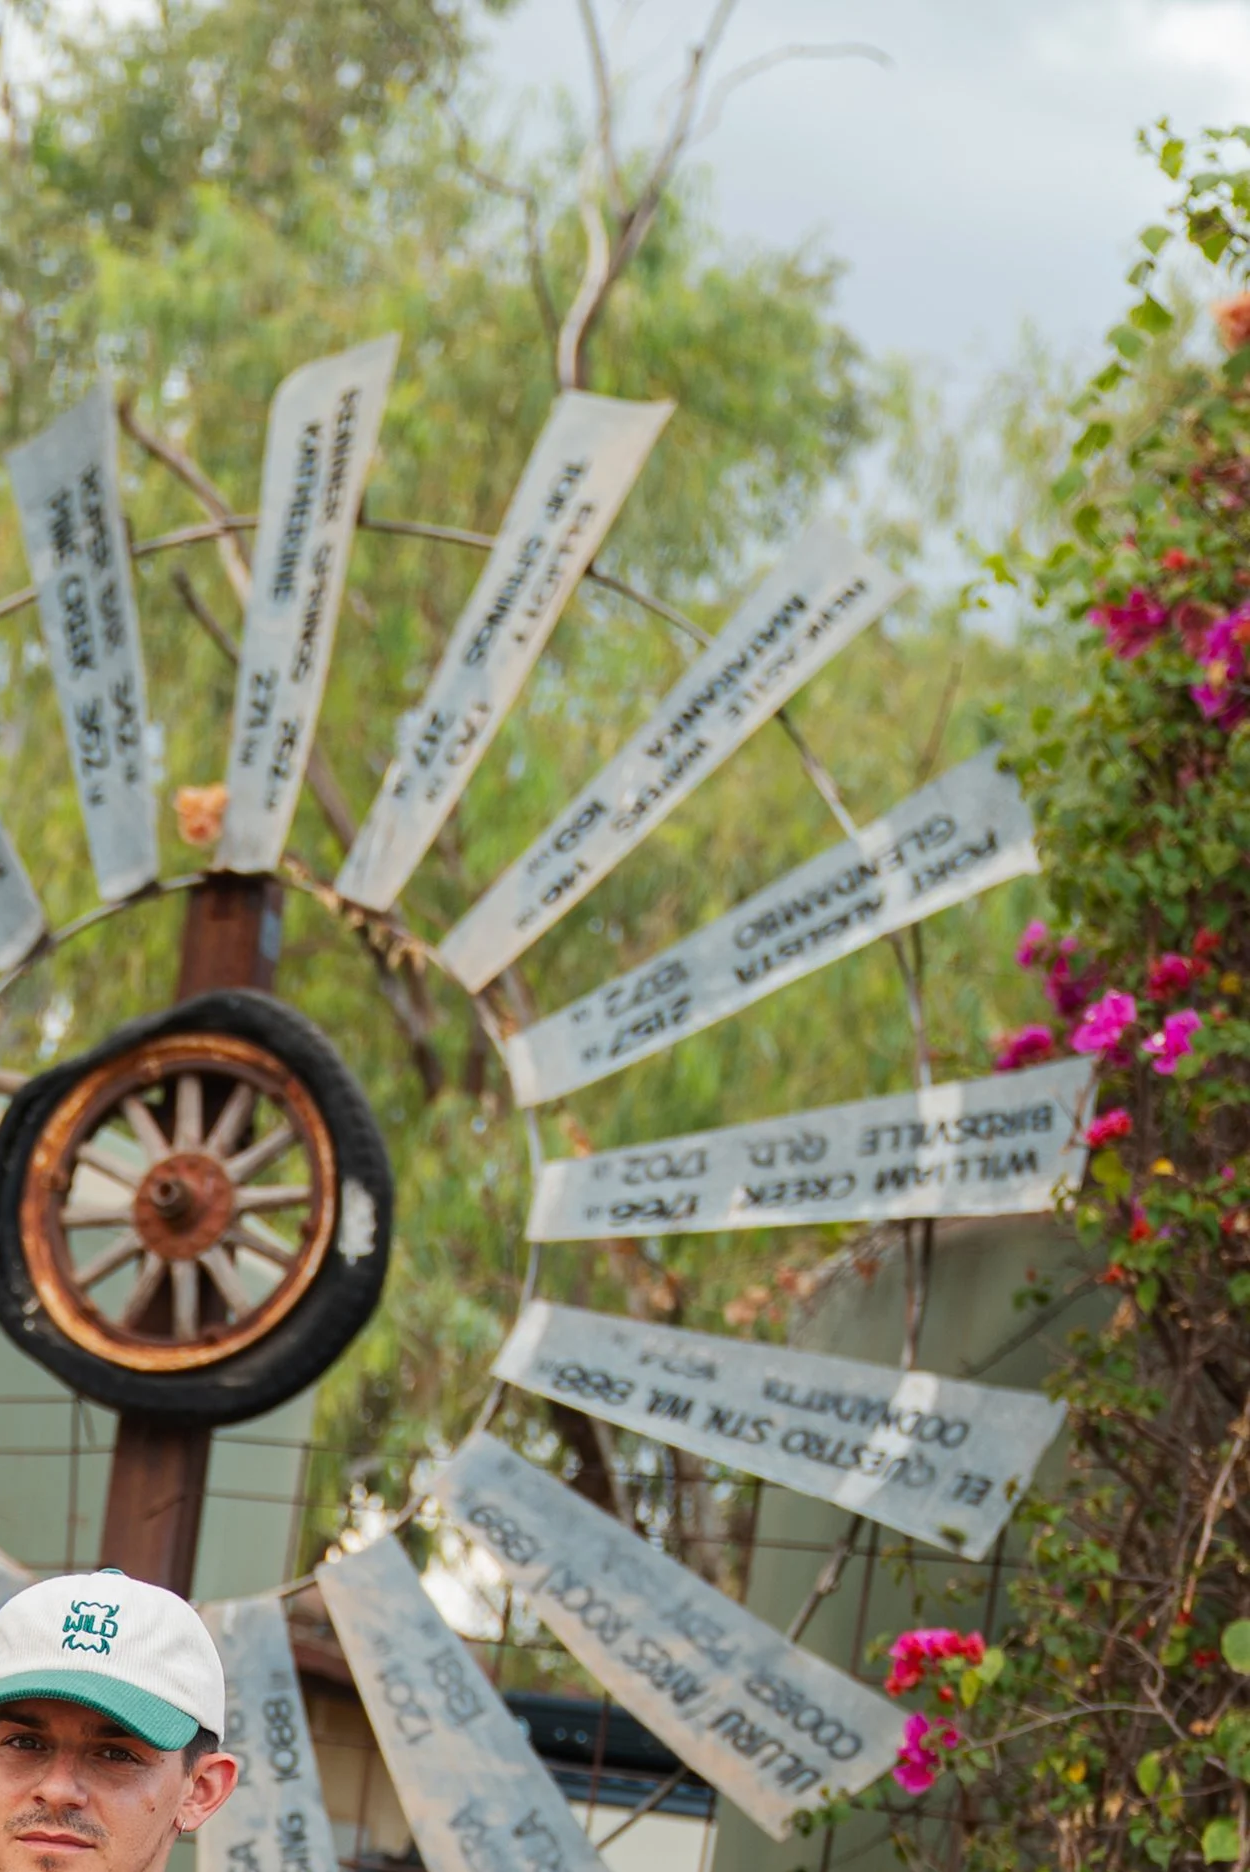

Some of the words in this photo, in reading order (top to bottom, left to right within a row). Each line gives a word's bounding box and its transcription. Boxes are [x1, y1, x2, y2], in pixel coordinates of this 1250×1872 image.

[269, 420, 323, 602] KATHERINE
[540, 457, 588, 524] TOP
[288, 542, 333, 684] SPRINGS
[461, 534, 546, 670] SPRINGS
[508, 498, 598, 647] ELLIOTT
[60, 574, 96, 674] CREEK
[640, 592, 811, 762] MATARANKA
[608, 735, 713, 836] WATERS
[726, 812, 968, 952] GLENDAMBO
[908, 828, 1000, 894] PORT
[730, 892, 888, 987] AUGUSTA
[619, 1148, 709, 1186] 1702
[858, 1102, 1054, 1156] BIRDSVILLE
[872, 1147, 1040, 1195] WILLIAM
[742, 1171, 856, 1208] CREEK
[550, 1362, 636, 1408] 888
[778, 1424, 939, 1491] QUESTRO
[950, 1470, 994, 1508] EL
[464, 1499, 544, 1570] 1389
[62, 1614, 118, 1639] WILD
[374, 1660, 434, 1746] 1201
[422, 1644, 486, 1728] 1381
[742, 1661, 864, 1768] COOBER
[262, 1696, 301, 1782] 1088
[705, 1702, 822, 1801] ULURU
